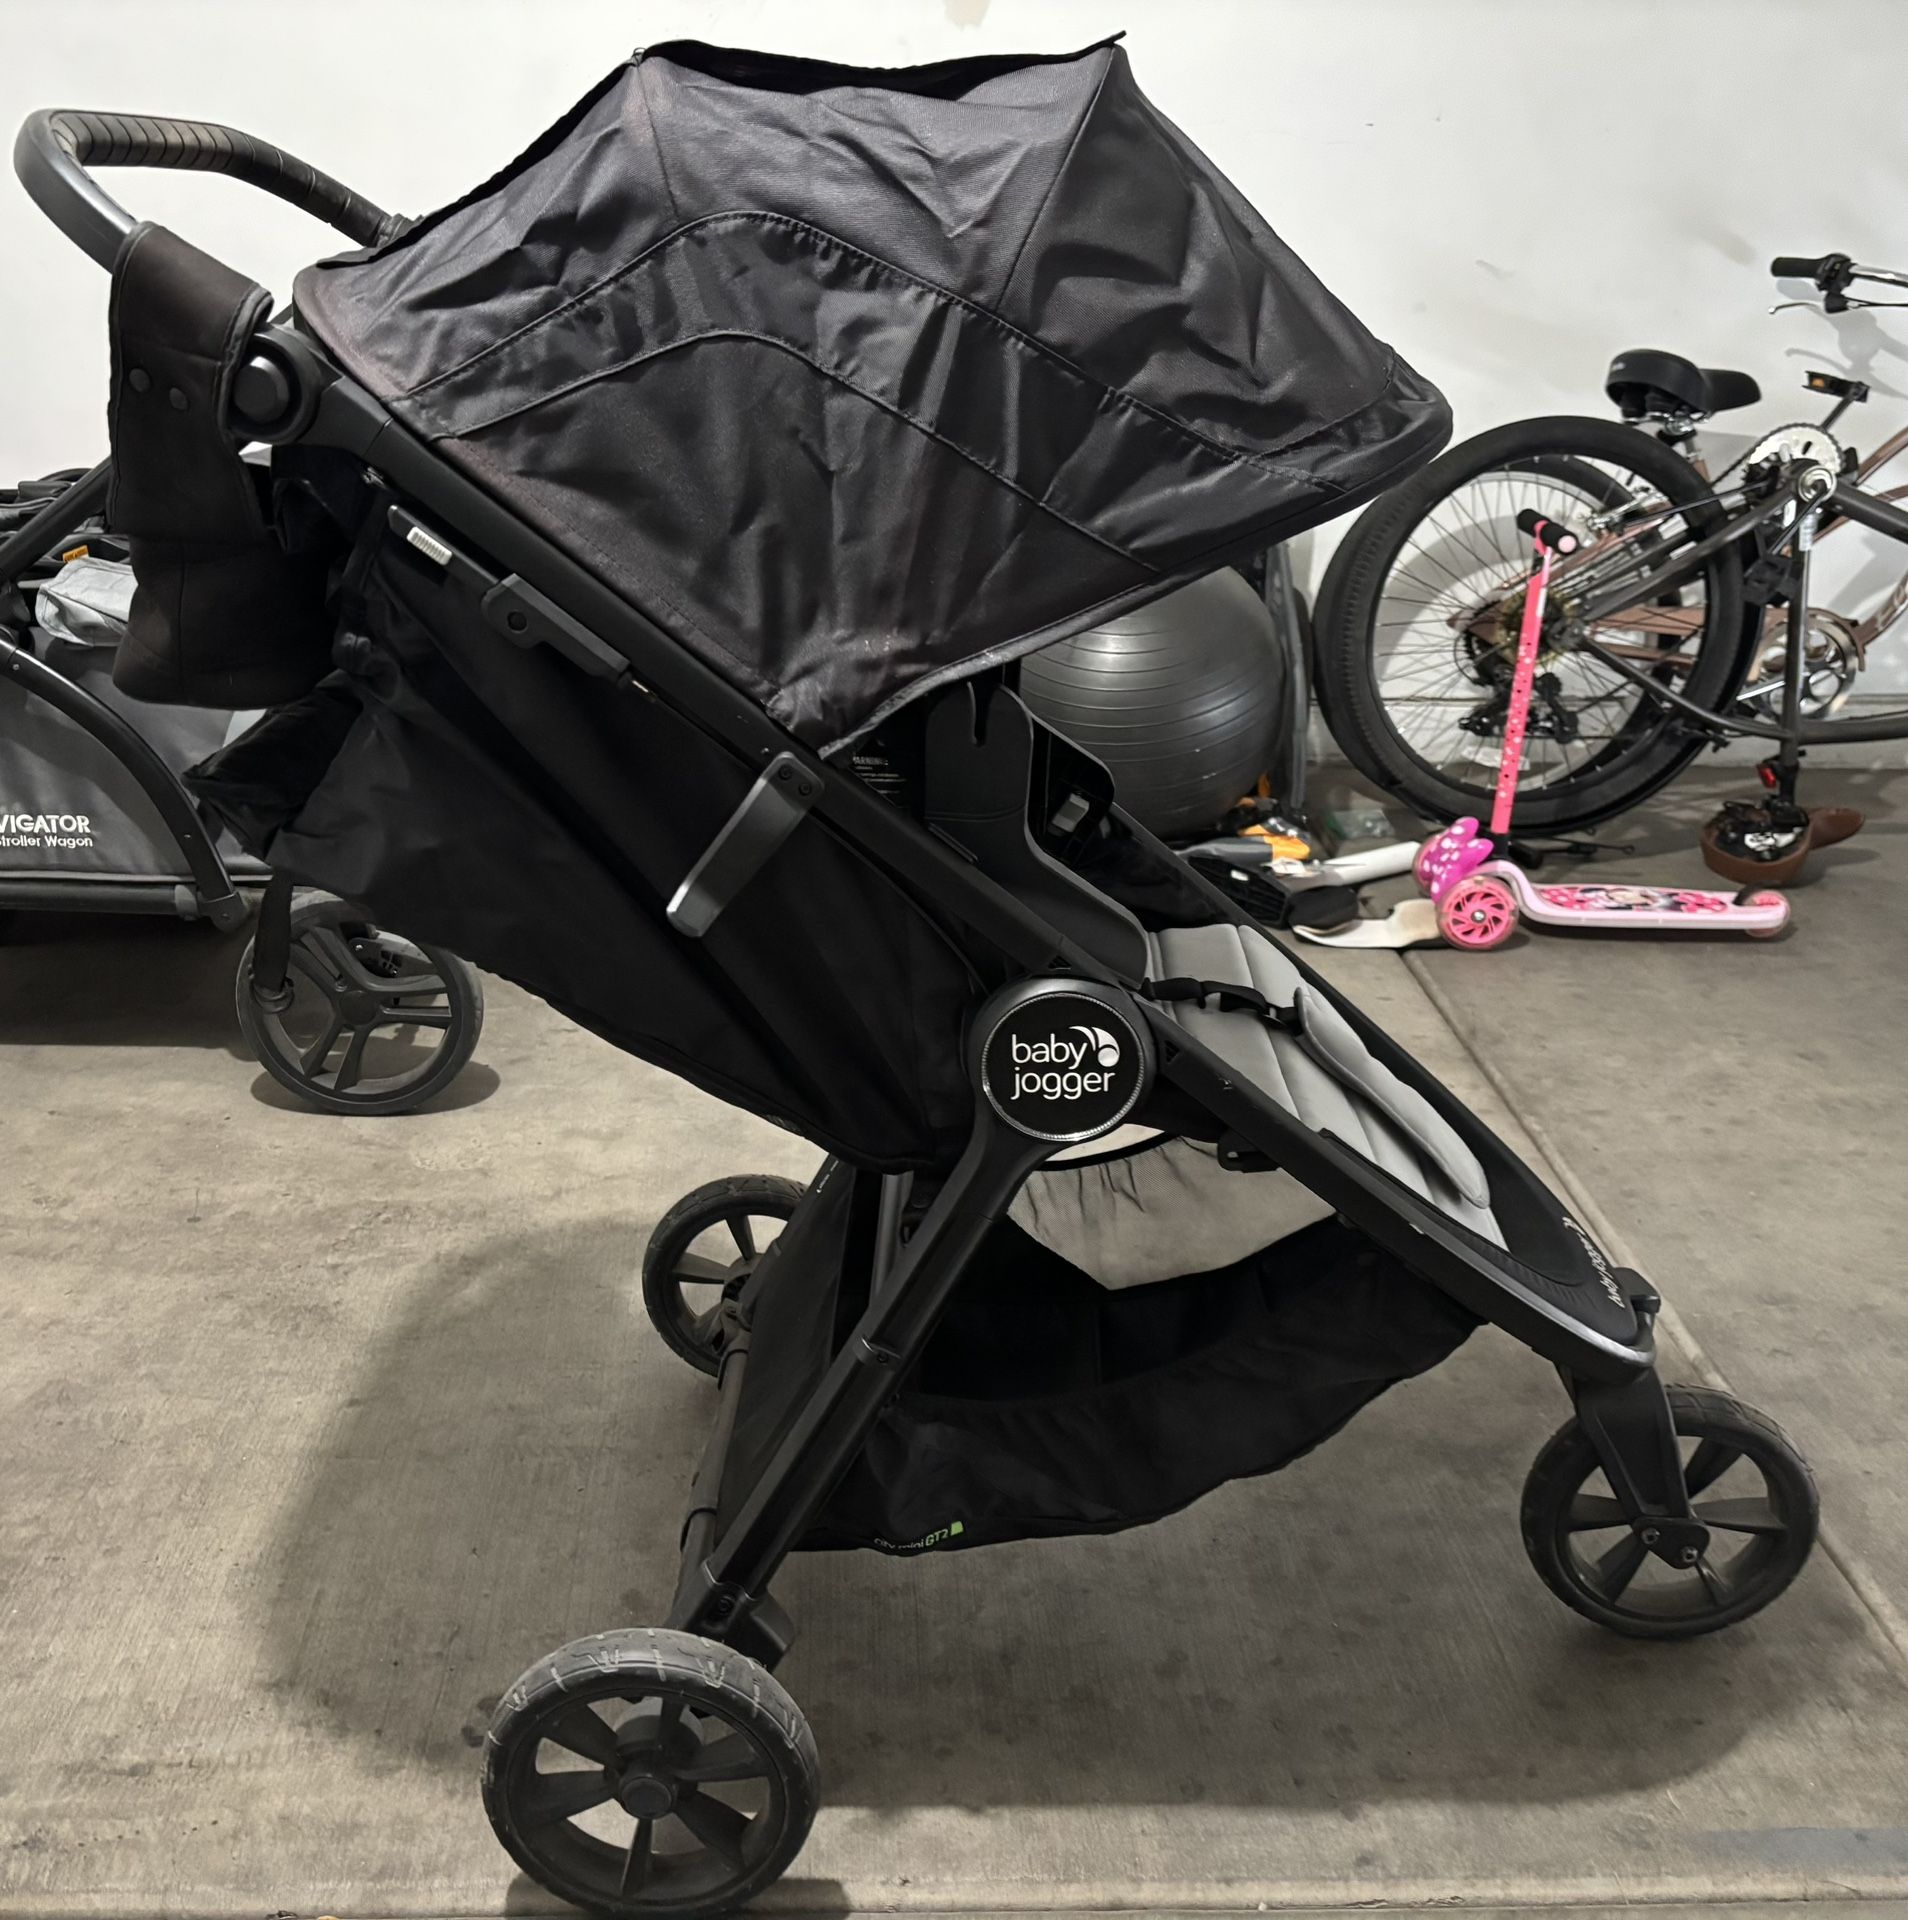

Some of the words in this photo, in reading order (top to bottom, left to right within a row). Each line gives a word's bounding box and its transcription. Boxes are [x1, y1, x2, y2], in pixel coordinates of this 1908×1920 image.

[0, 814, 91, 834] VIGATOR
[44, 835, 94, 849] Wagon
[1011, 1033, 1088, 1070] baby
[1010, 1066, 1116, 1101] jogger
